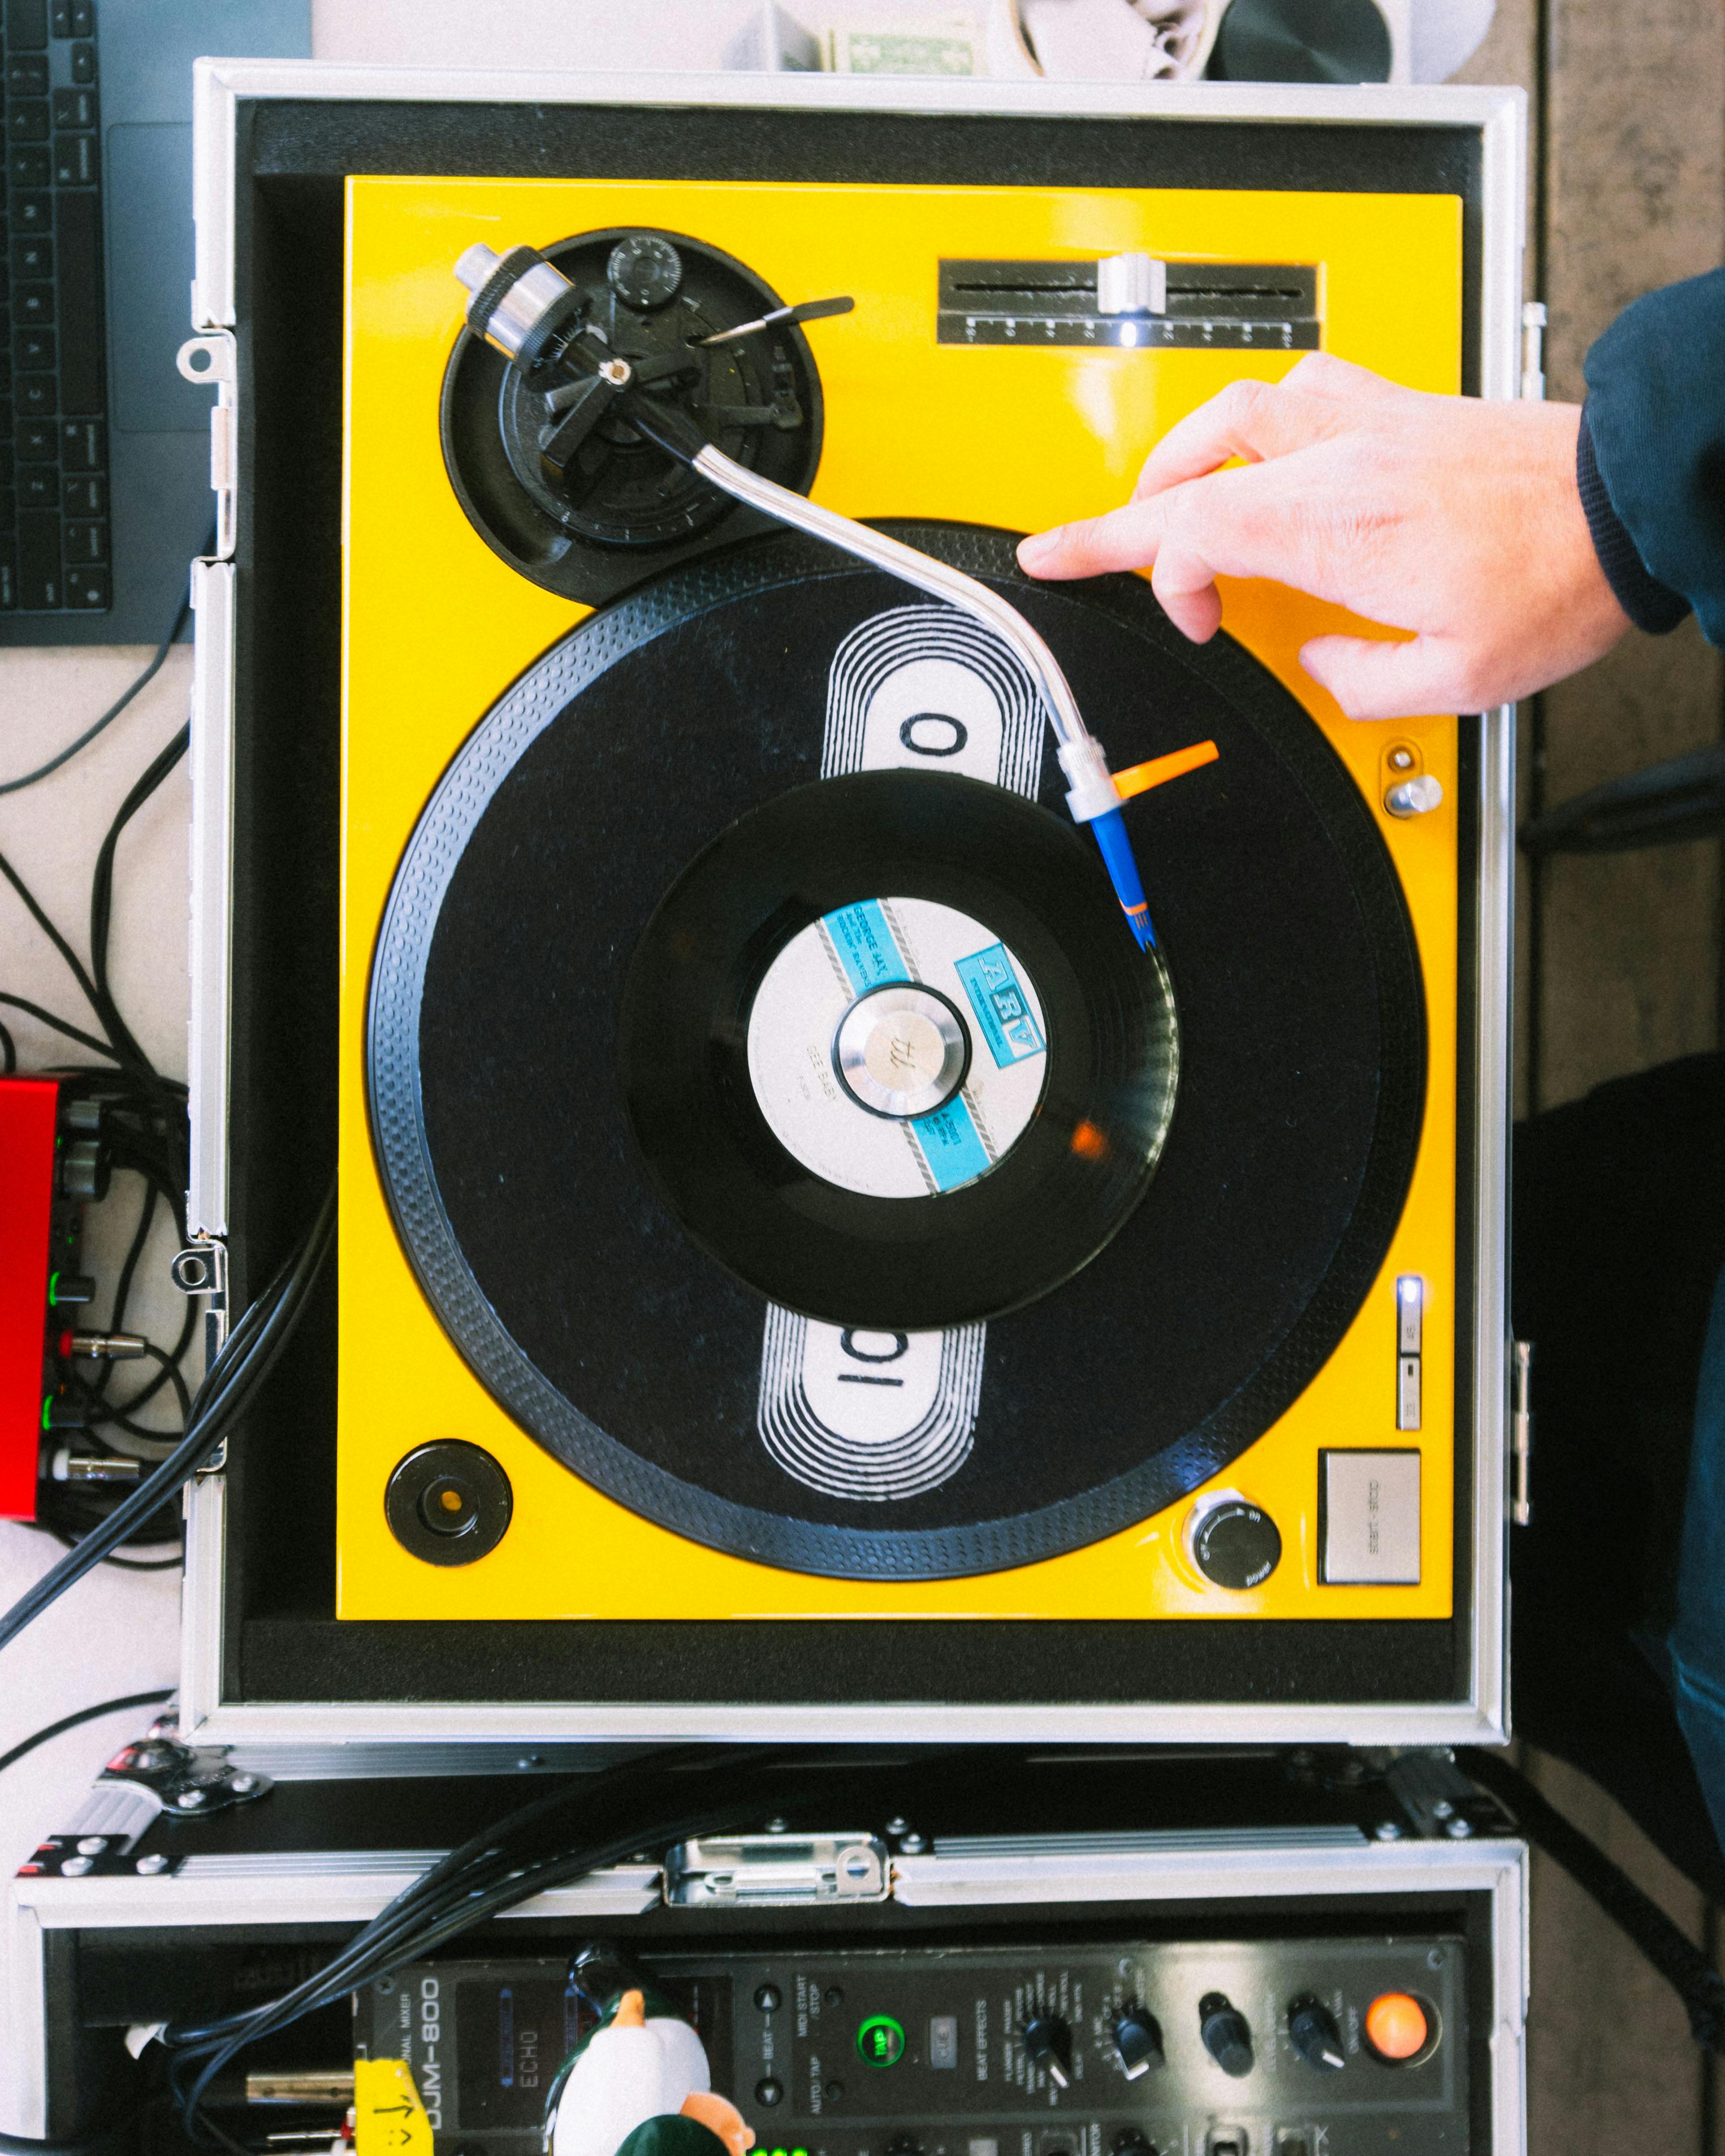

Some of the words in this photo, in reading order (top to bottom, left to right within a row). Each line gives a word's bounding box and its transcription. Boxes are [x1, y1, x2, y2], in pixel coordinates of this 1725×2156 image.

[851, 906, 879, 951] GEORGE
[851, 952, 872, 988] RAVENS
[978, 955, 1037, 1050] ARV
[401, 1993, 411, 2028] MIXER
[797, 1975, 807, 2010] START
[976, 1999, 987, 2049] EFFECTS
[421, 1978, 442, 2129] DJM-800
[520, 2032, 538, 2088] ECHO
[763, 2031, 773, 2059] BEAT
[976, 2053, 988, 2080] BEAT
